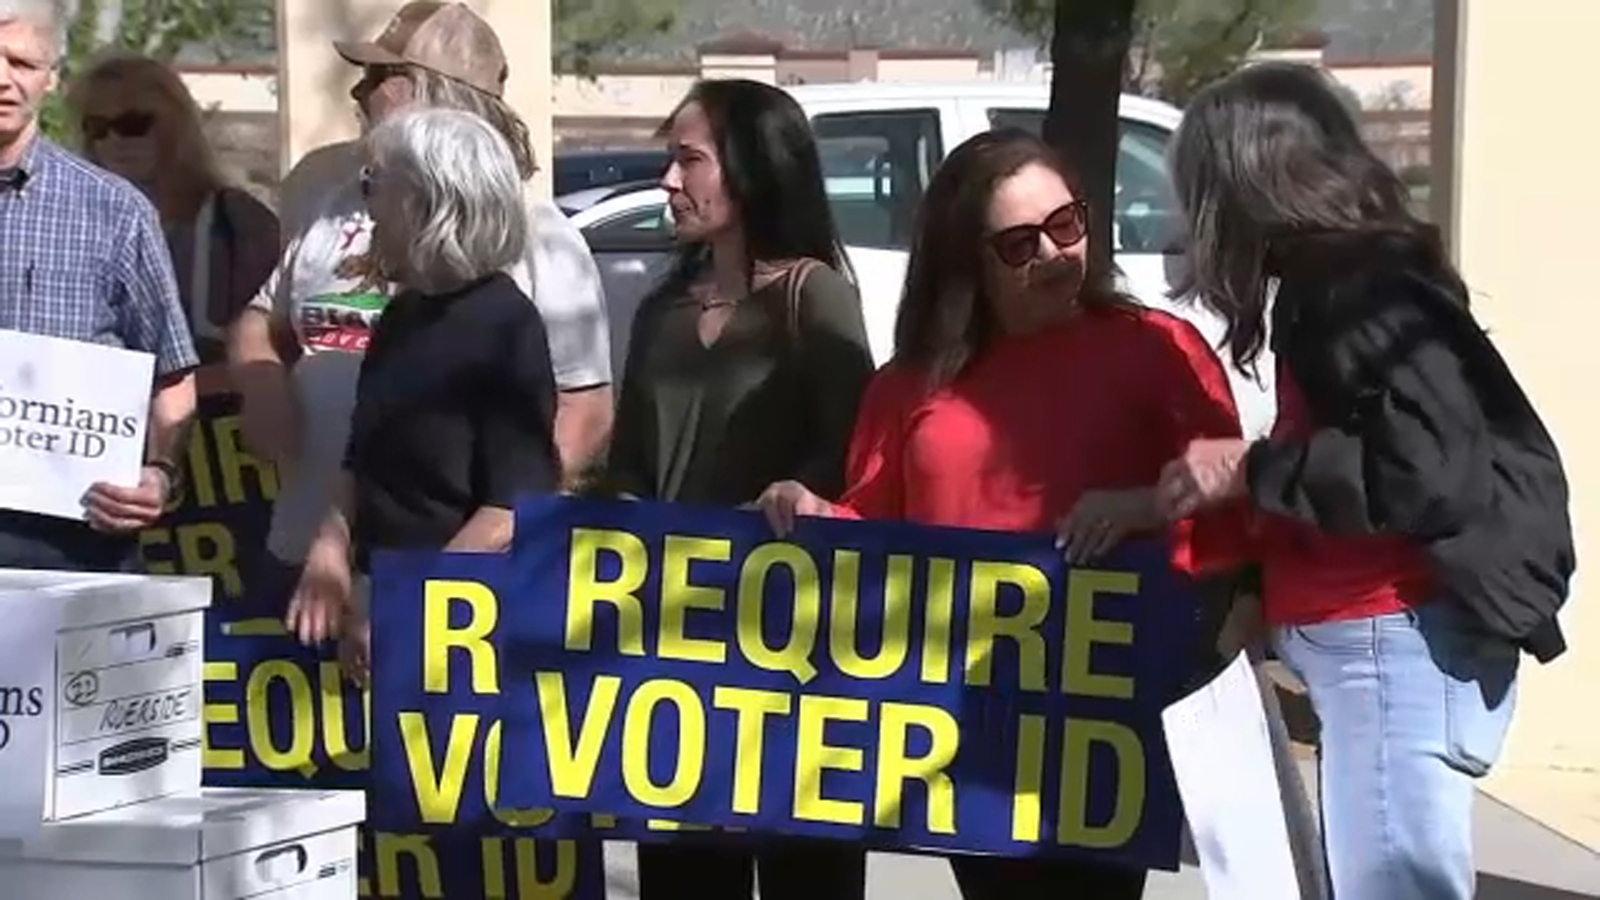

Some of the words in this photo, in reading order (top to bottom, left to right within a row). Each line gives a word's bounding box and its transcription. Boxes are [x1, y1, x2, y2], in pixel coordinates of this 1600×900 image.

[0, 397, 138, 439] ornians
[69, 431, 106, 458] ID
[564, 527, 1141, 699] REQUIRE
[535, 671, 961, 836] VOTER
[1012, 713, 1146, 849] ID
